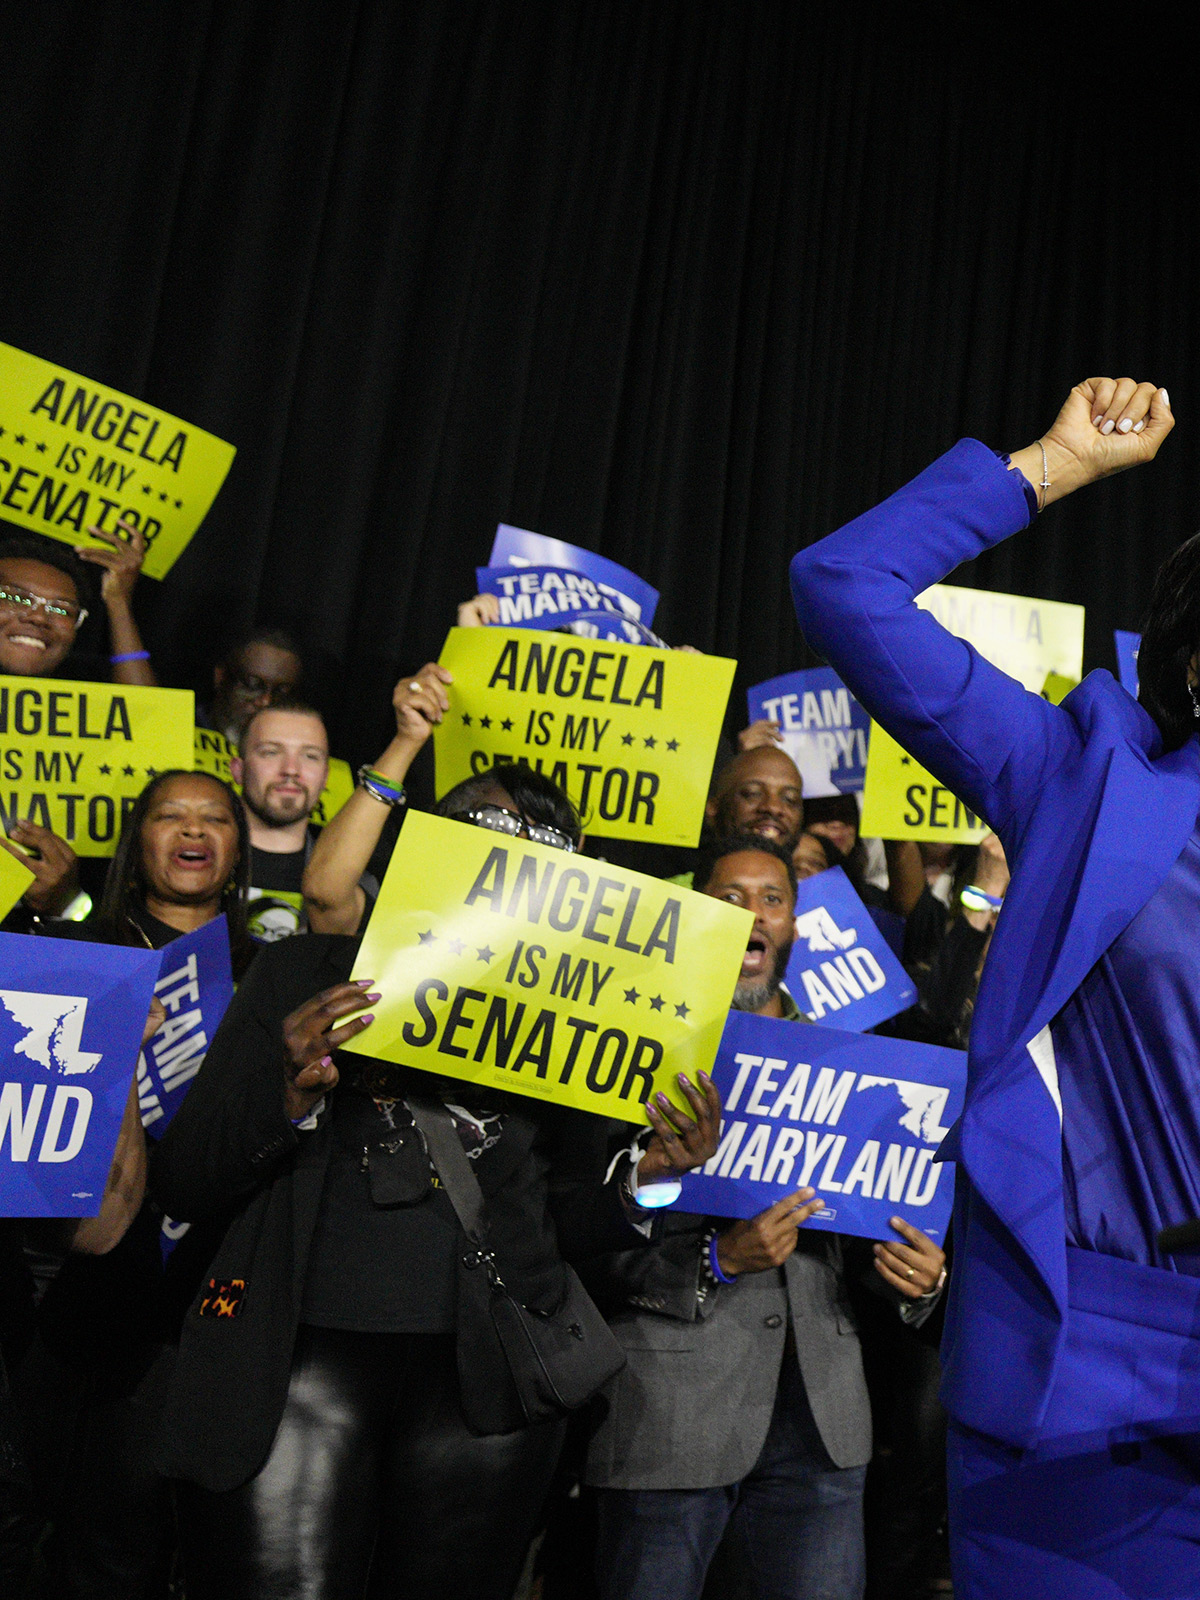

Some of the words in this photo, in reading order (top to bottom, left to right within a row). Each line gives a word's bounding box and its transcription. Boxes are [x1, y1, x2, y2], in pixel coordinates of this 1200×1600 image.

[29, 377, 189, 474] ANGELA
[54, 443, 88, 475] IS
[87, 456, 136, 493] MY
[496, 571, 598, 596] TEAM
[487, 639, 666, 711] ANGELA
[761, 687, 852, 731] TEAM
[34, 750, 84, 783] MY
[524, 709, 555, 747] IS
[560, 714, 612, 753] MY
[463, 846, 682, 965] ANGELA
[504, 939, 547, 989] IS
[549, 953, 615, 1007] MY
[805, 946, 887, 1022] AND
[401, 977, 664, 1104] SENATOR
[724, 1052, 857, 1127] TEAM
[691, 1119, 945, 1208] MARYLAND
